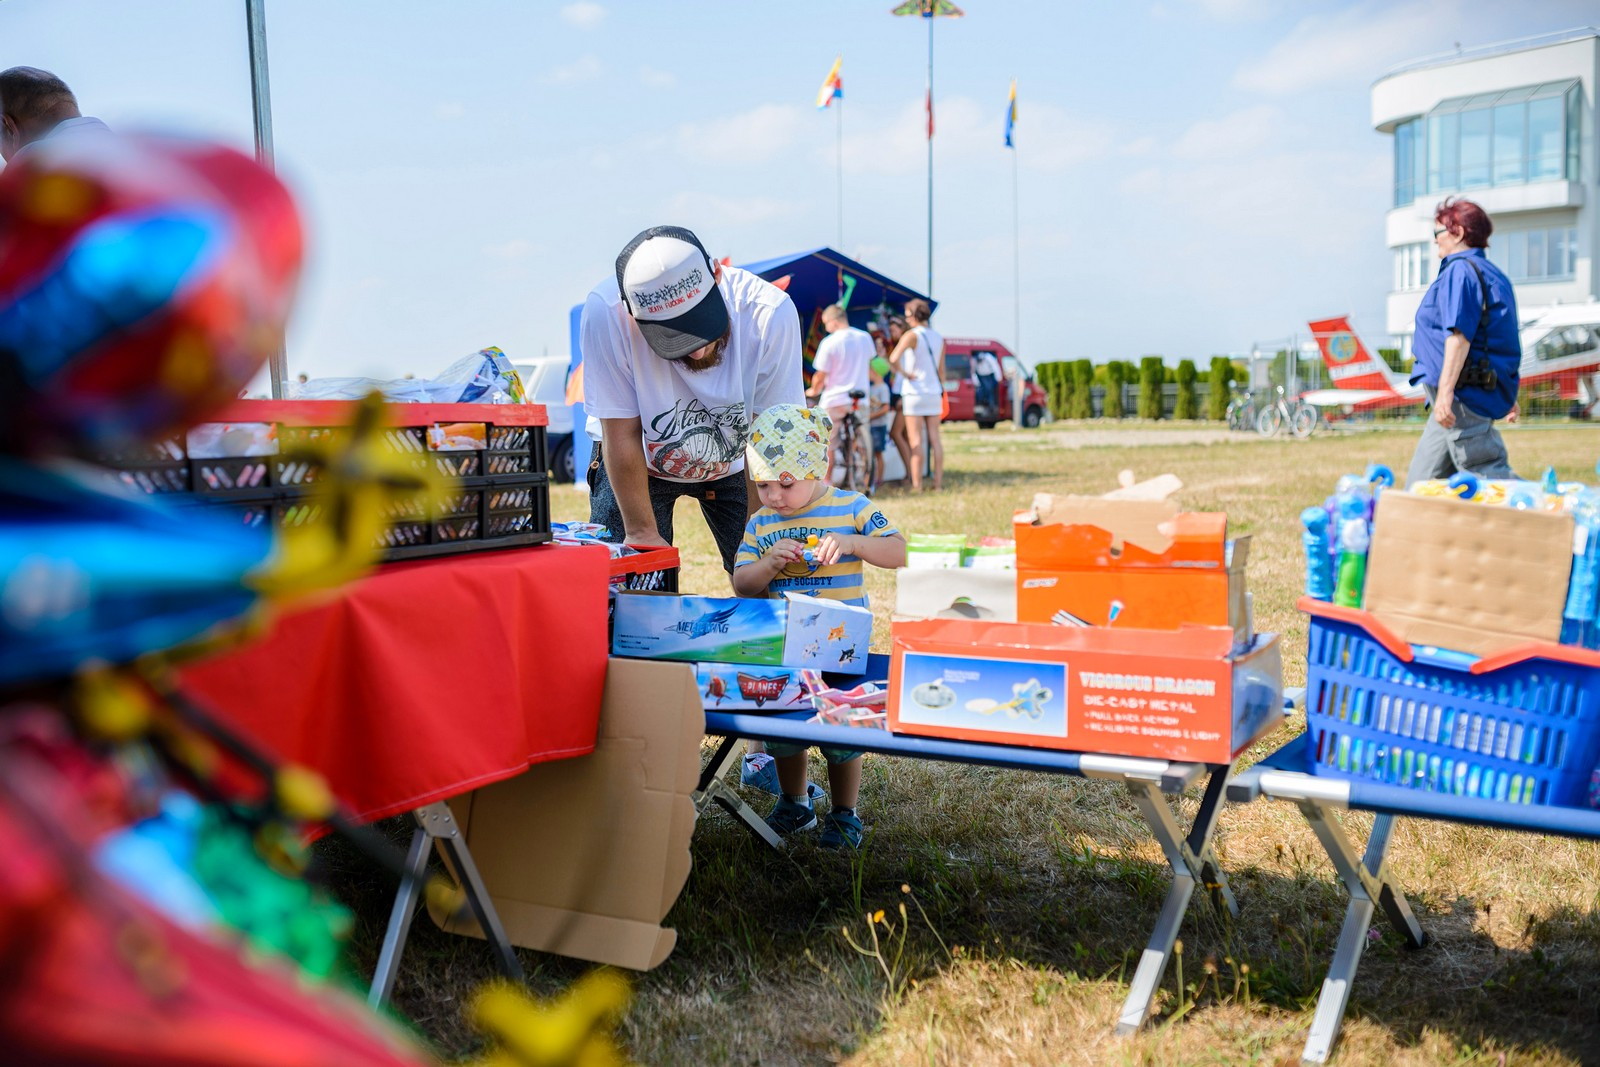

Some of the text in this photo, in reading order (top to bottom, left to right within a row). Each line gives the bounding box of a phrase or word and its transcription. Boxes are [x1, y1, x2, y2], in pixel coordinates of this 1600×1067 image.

[647, 304, 664, 314] DEATH
[665, 296, 686, 309] FUCKING
[870, 511, 888, 529] 6
[756, 526, 832, 555] UNIVERSI
[794, 576, 833, 586] SOCIETY
[747, 681, 778, 693] PLANES
[1083, 694, 1198, 714] DIE-CAST METAL
